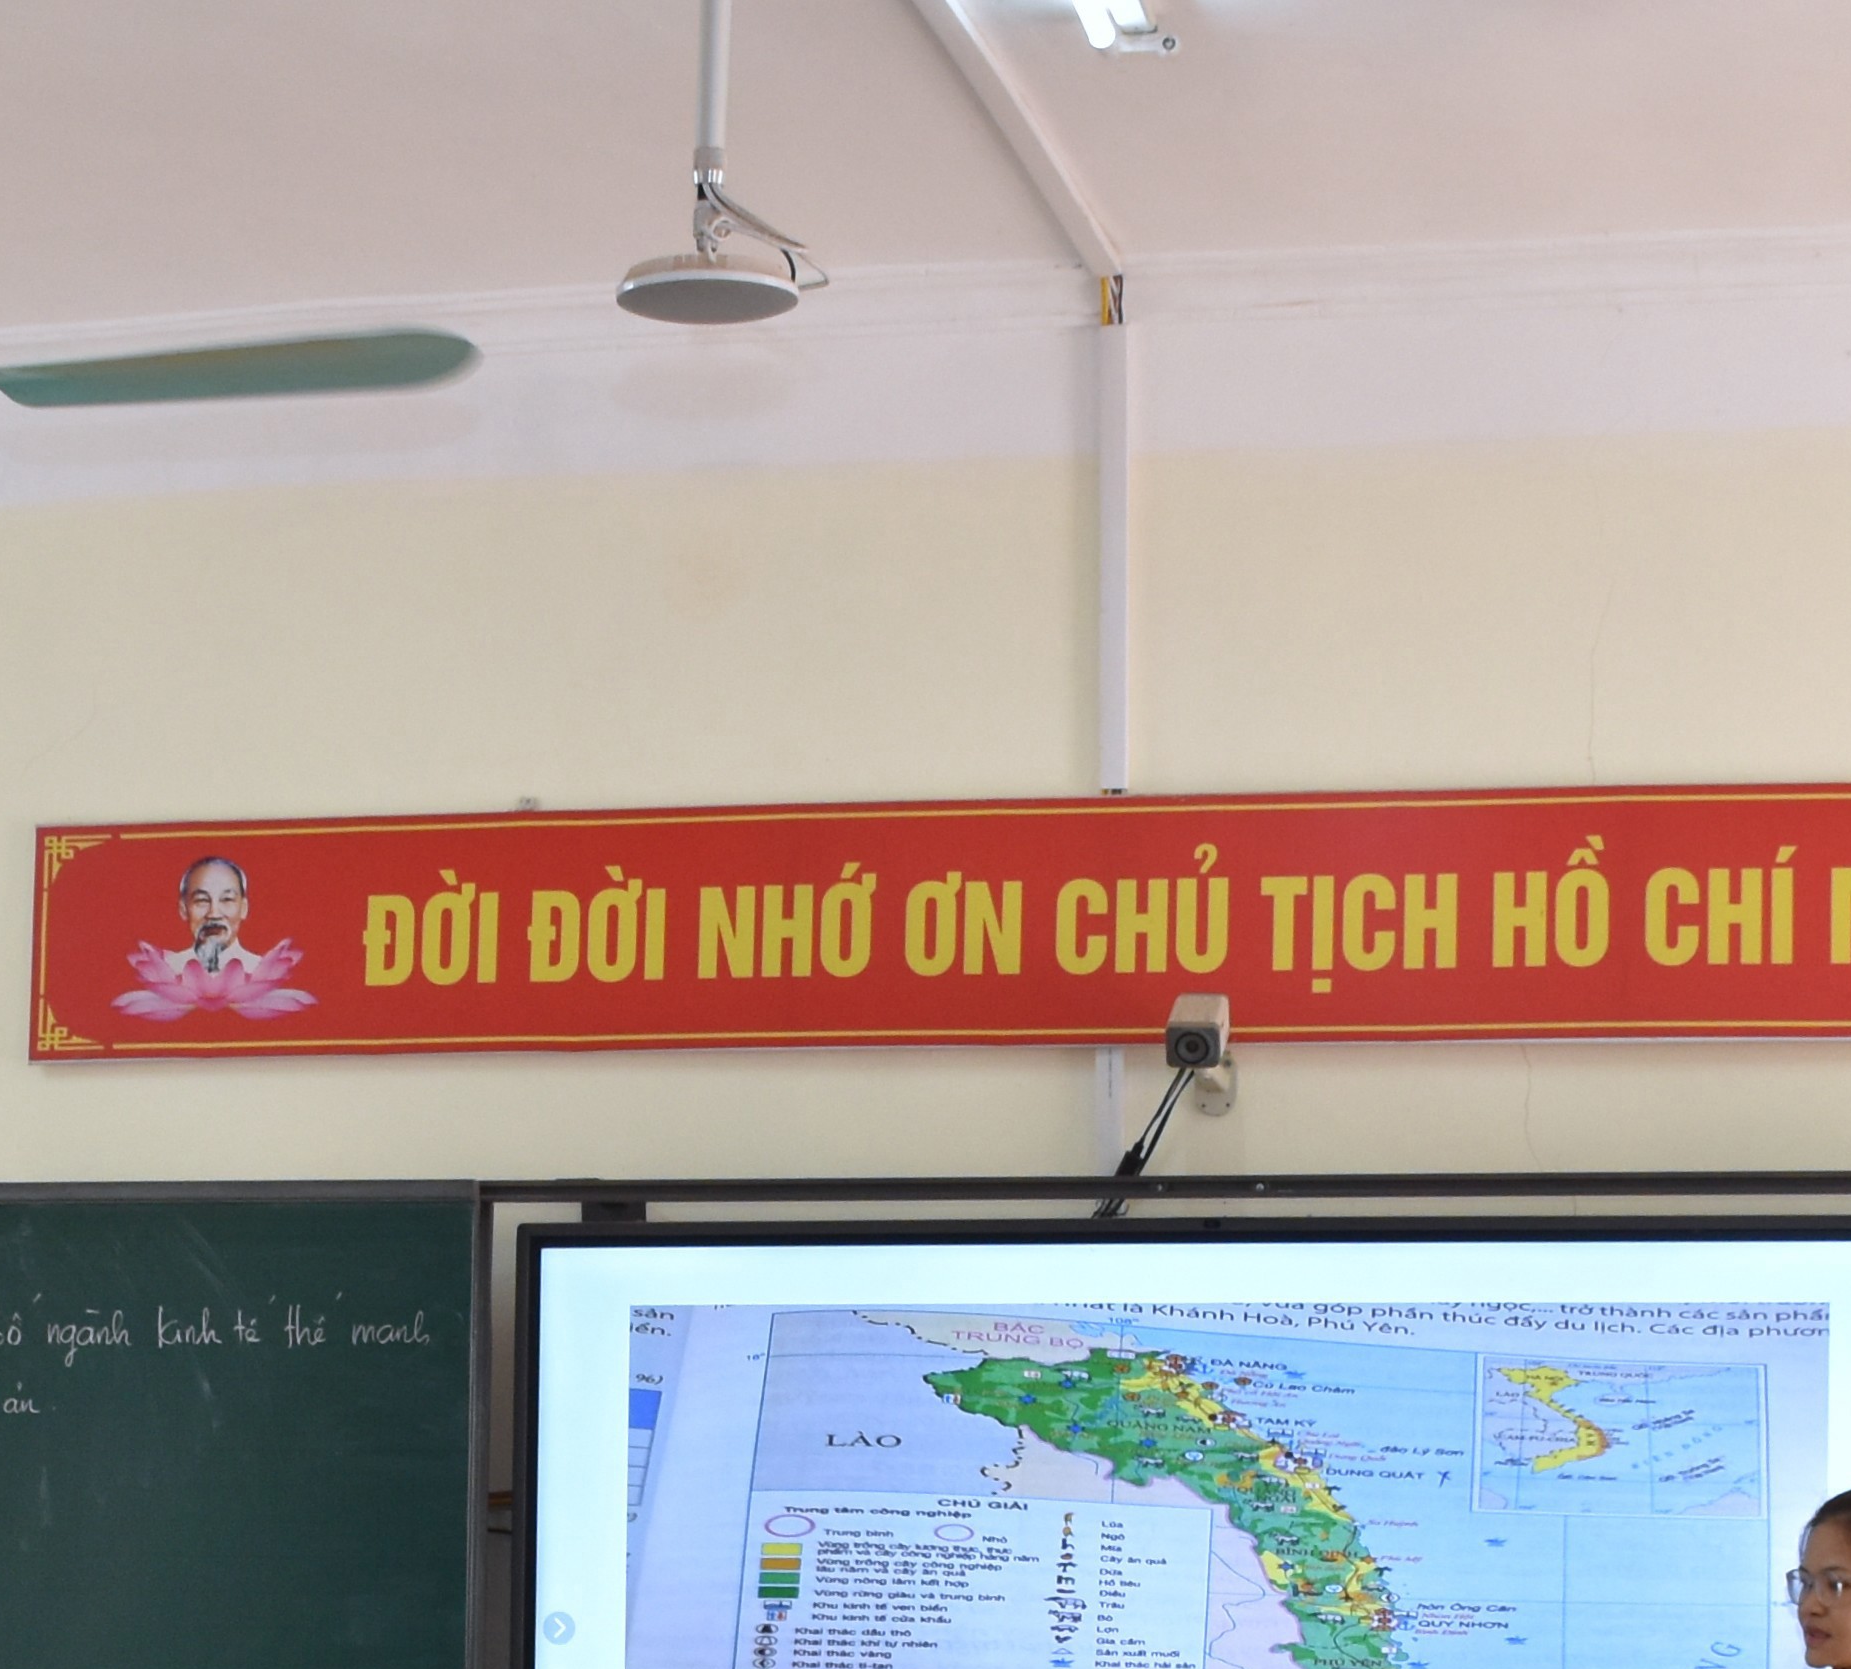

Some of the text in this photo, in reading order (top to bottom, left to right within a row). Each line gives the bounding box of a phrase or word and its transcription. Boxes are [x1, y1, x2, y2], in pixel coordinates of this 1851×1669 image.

[363, 870, 498, 985] ĐỜI
[528, 866, 665, 982] ĐỜI
[698, 863, 876, 978] NHỚ
[905, 872, 1022, 975] ƠN
[1056, 844, 1228, 974] CHỦ
[1261, 874, 1457, 993] TỊCH
[1493, 836, 1609, 967] HỒ
[1645, 846, 1796, 965] CHÍ
[1153, 1304, 1234, 1322] Khánh
[1243, 1312, 1299, 1329] Hoà,
[1307, 1315, 1356, 1332] Phú
[1363, 1319, 1415, 1336] Yên.
[1369, 1302, 1434, 1321] phần
[1442, 1309, 1496, 1326] thúc
[1504, 1310, 1547, 1331] đẩy
[1554, 1315, 1586, 1331] du
[1594, 1319, 1641, 1336] lịch.
[1649, 1321, 1693, 1336] Các
[1702, 1322, 1739, 1338] địa
[952, 1331, 1040, 1345] TRUNG
[825, 1431, 902, 1447] LÀO
